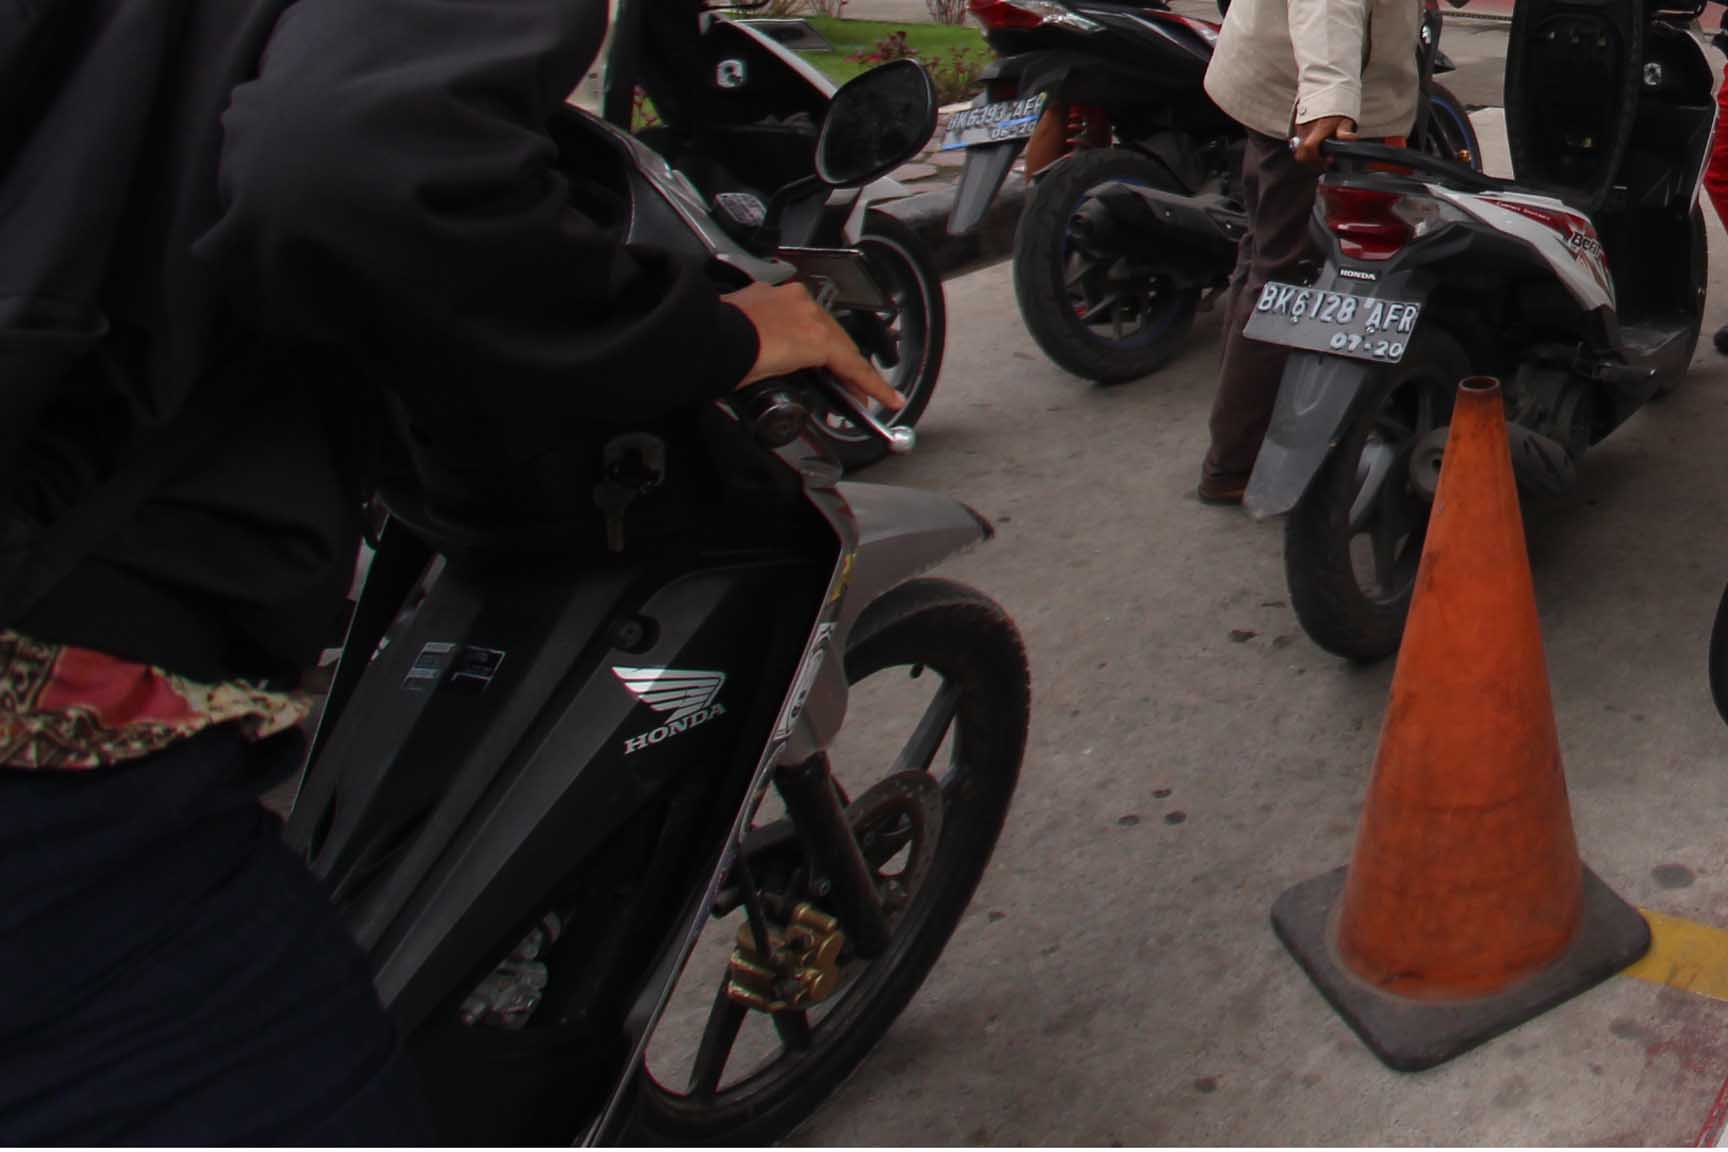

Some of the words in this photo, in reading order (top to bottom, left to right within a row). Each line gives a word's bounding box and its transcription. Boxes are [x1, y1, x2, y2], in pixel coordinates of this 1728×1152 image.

[1340, 269, 1377, 281] HONDA
[1365, 302, 1418, 333] AFR
[623, 702, 727, 755] HONDA
